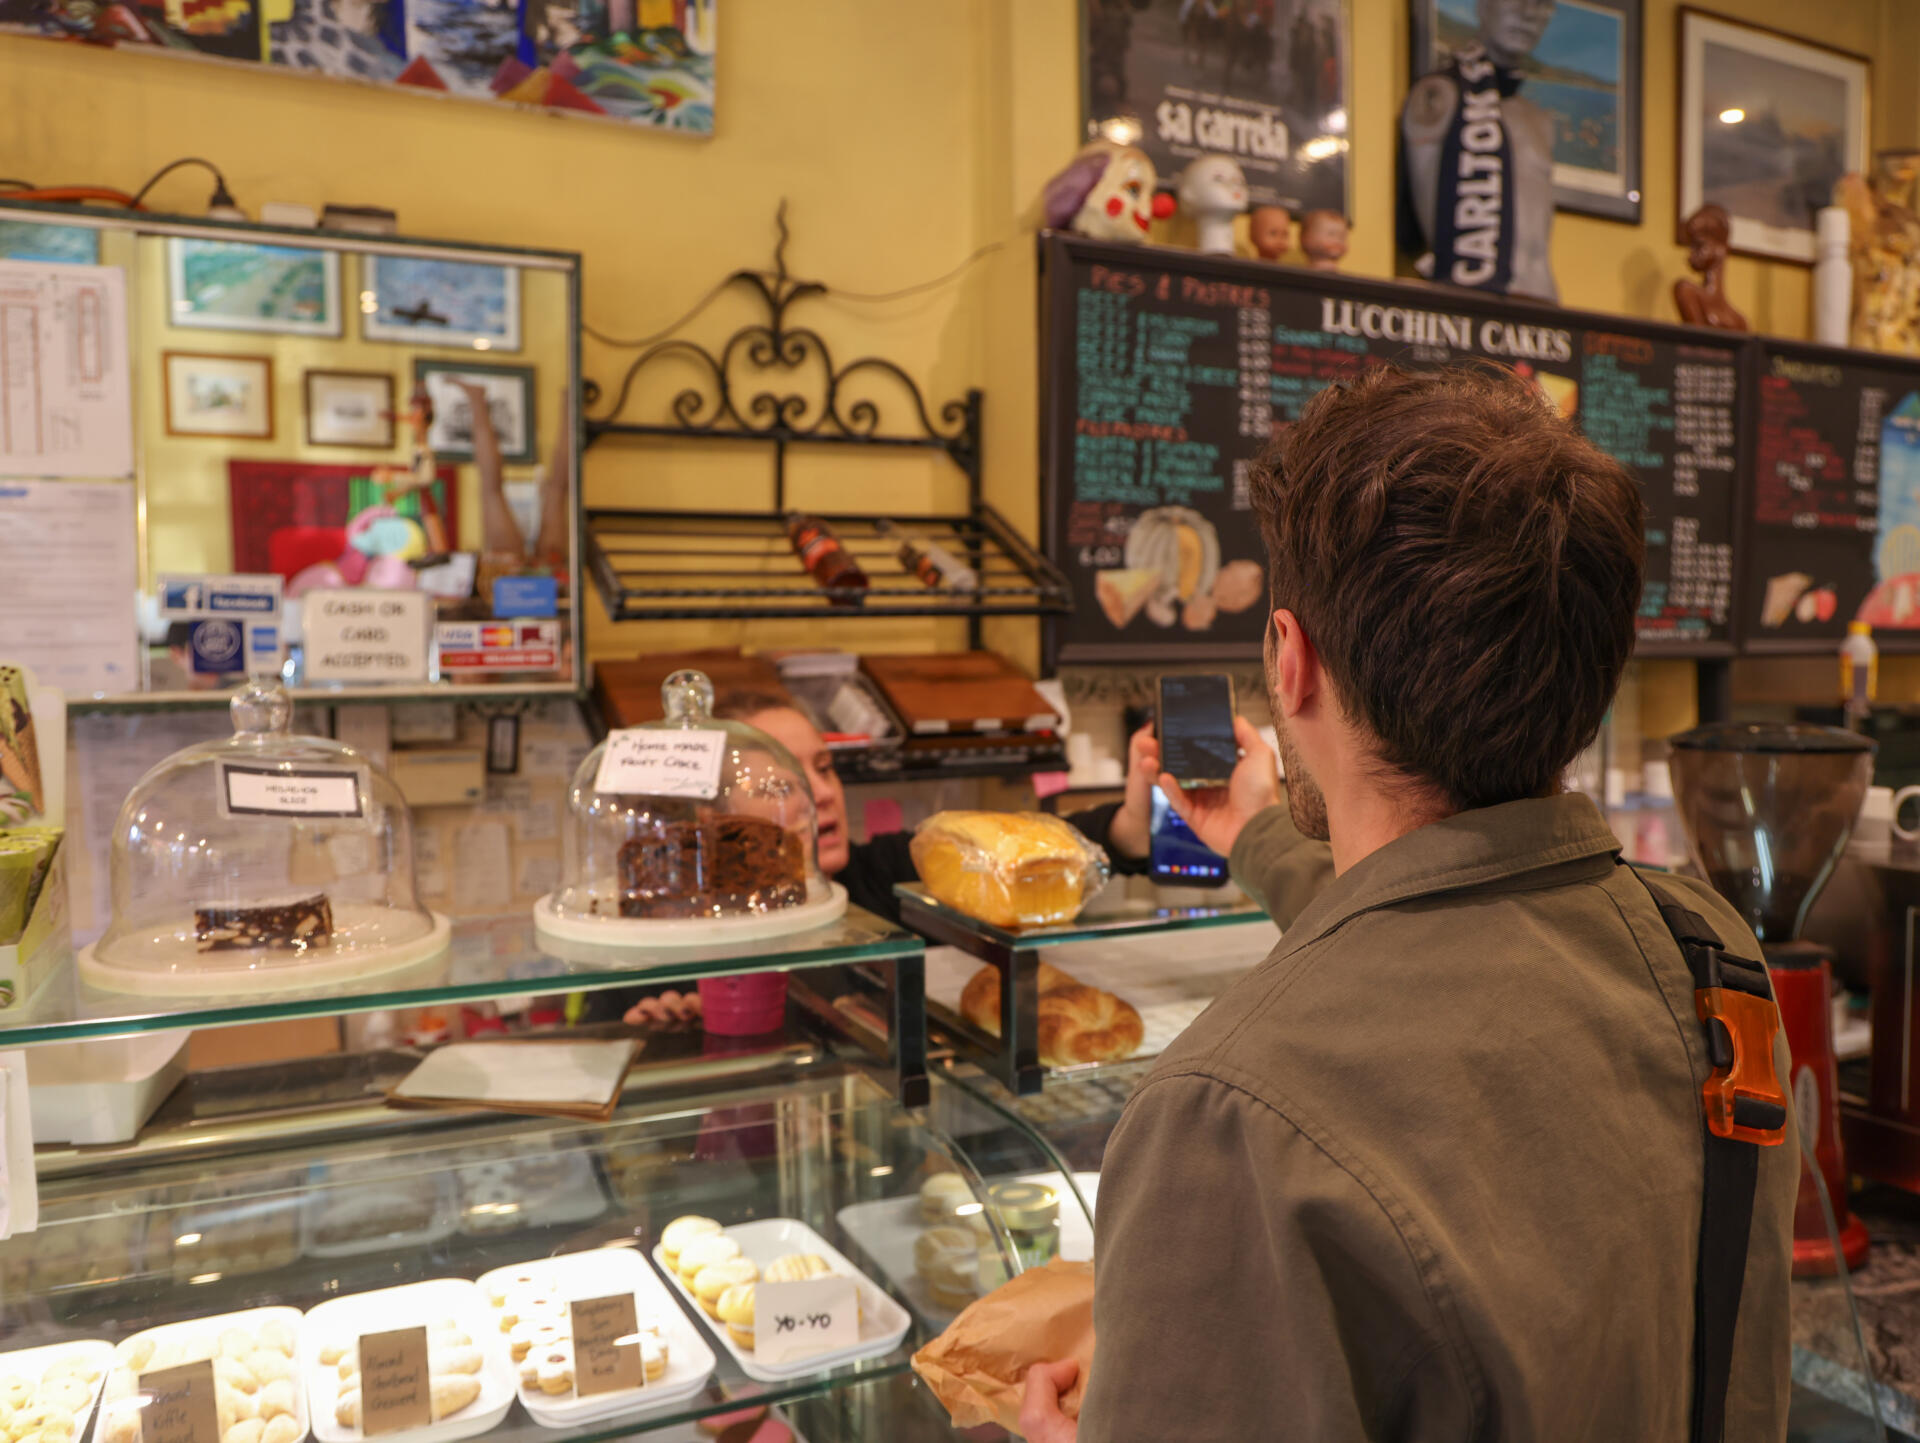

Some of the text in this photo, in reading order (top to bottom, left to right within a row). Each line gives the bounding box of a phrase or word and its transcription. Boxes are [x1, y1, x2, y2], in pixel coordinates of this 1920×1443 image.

[1321, 298, 1572, 363] LUCCHINI CAKES
[322, 599, 375, 618] CASH
[319, 650, 411, 669] ACCEPTED
